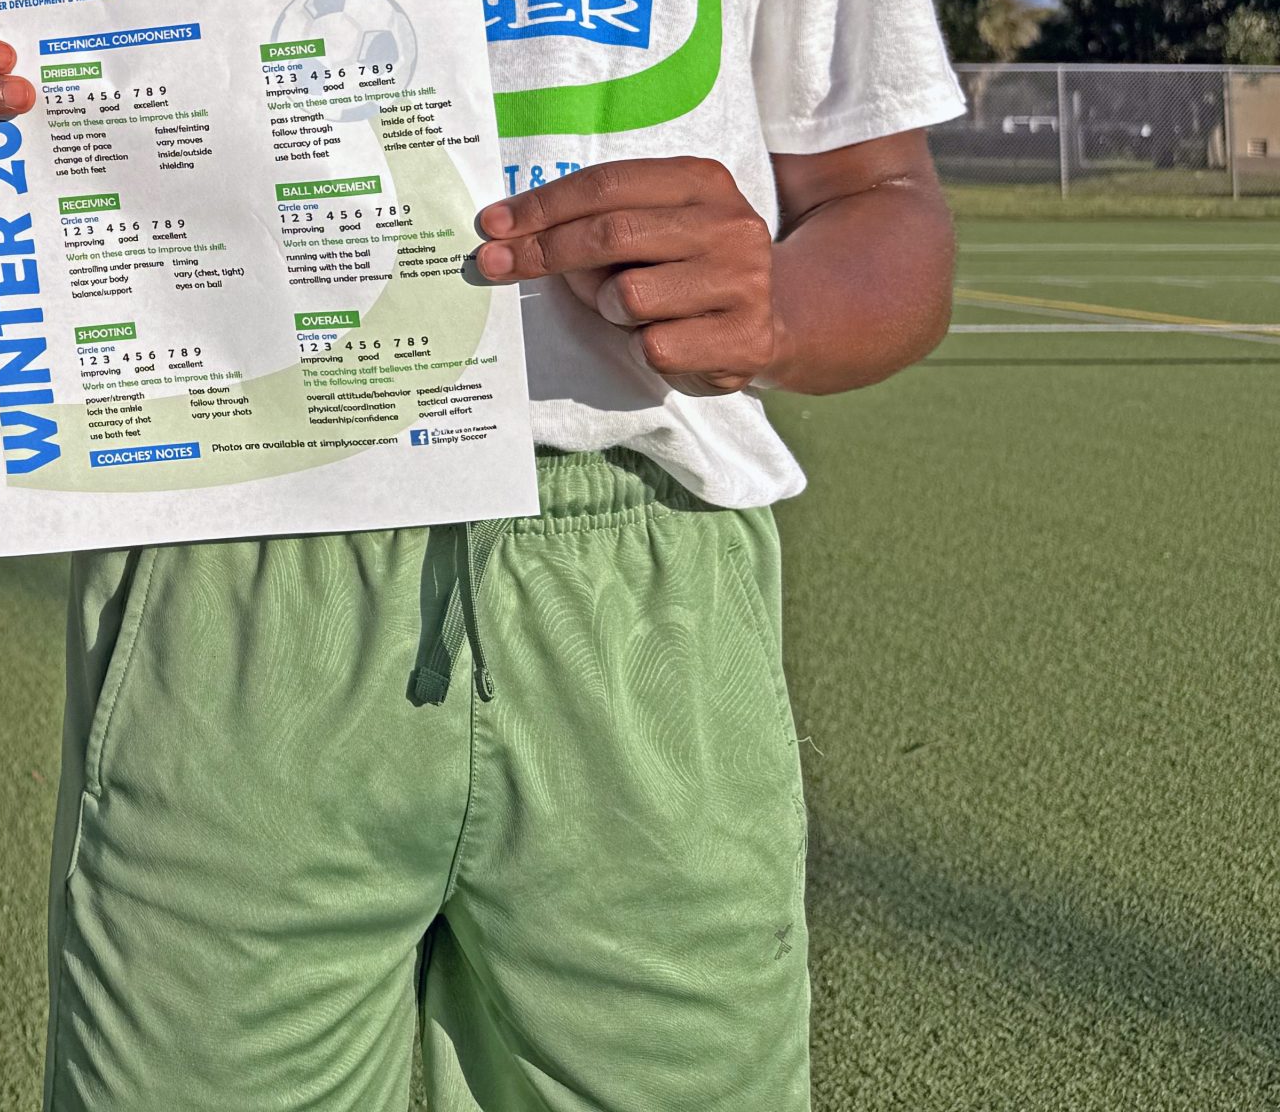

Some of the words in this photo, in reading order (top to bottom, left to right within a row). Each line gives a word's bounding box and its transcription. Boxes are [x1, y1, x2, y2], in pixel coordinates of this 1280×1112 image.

[47, 37, 110, 52] TECHNICAL
[112, 28, 192, 45] COMPONENTS
[269, 44, 316, 57] PASSING
[43, 66, 100, 79] DRIBBLING
[262, 64, 285, 73] Circle
[265, 76, 269, 85] 1
[276, 75, 284, 84] 2
[290, 73, 297, 82] 3
[311, 71, 318, 80] 4
[324, 70, 331, 79] 5
[338, 68, 346, 77] 6
[358, 66, 365, 75] 7
[372, 65, 379, 74] 8
[385, 63, 393, 73] 9
[266, 87, 309, 97] improving
[323, 82, 344, 92] good
[359, 77, 396, 88] excellent
[380, 105, 398, 113] look
[425, 100, 452, 109] target
[271, 118, 288, 126] pass
[290, 112, 324, 122] strength
[381, 117, 404, 126] inside
[406, 115, 415, 123] of
[417, 114, 435, 122] foot
[384, 142, 407, 151] strike
[409, 140, 435, 149] center
[437, 138, 445, 146] of
[447, 137, 461, 145] the
[463, 135, 480, 143] ball
[283, 186, 311, 196] BALL
[313, 180, 376, 194] MOVEMENT
[62, 198, 116, 210] RECEIVING
[302, 315, 353, 326] OVERALL
[78, 327, 133, 340] SHOOTING
[307, 393, 335, 401] overall
[337, 389, 411, 400] attitude/behavior
[416, 383, 482, 396] speed/quickness
[86, 392, 145, 406] power/strength
[417, 397, 448, 406] tactical
[450, 394, 493, 403] awareness
[308, 402, 396, 414] physical/coordination
[418, 409, 447, 418] overall
[449, 407, 472, 415] effort
[309, 414, 398, 424] leadership/confidence
[212, 444, 242, 452] Photos
[263, 440, 305, 449] available
[320, 437, 398, 448] simplysoccer.com
[432, 436, 458, 444] Simply
[97, 450, 152, 464] COACHES'
[156, 447, 192, 459] NOTES
